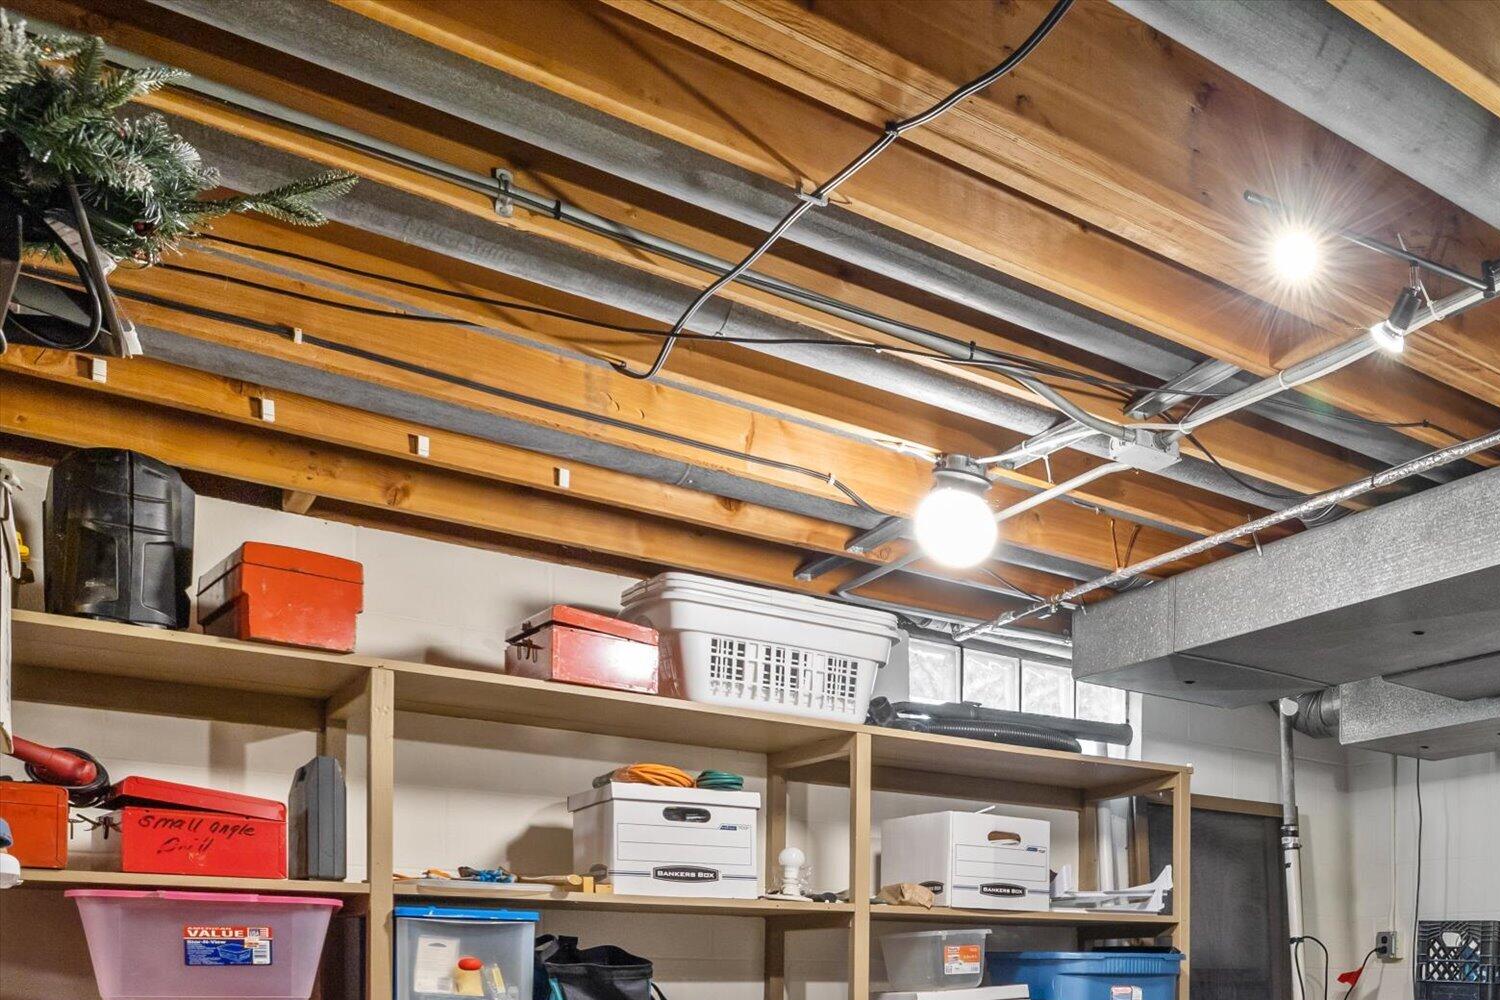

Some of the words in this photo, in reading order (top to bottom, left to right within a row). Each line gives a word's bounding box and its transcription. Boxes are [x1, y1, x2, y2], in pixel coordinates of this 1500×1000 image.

[657, 870, 696, 878] BANKERS
[982, 886, 1011, 894] BANKERS
[187, 929, 244, 937] VALUE
